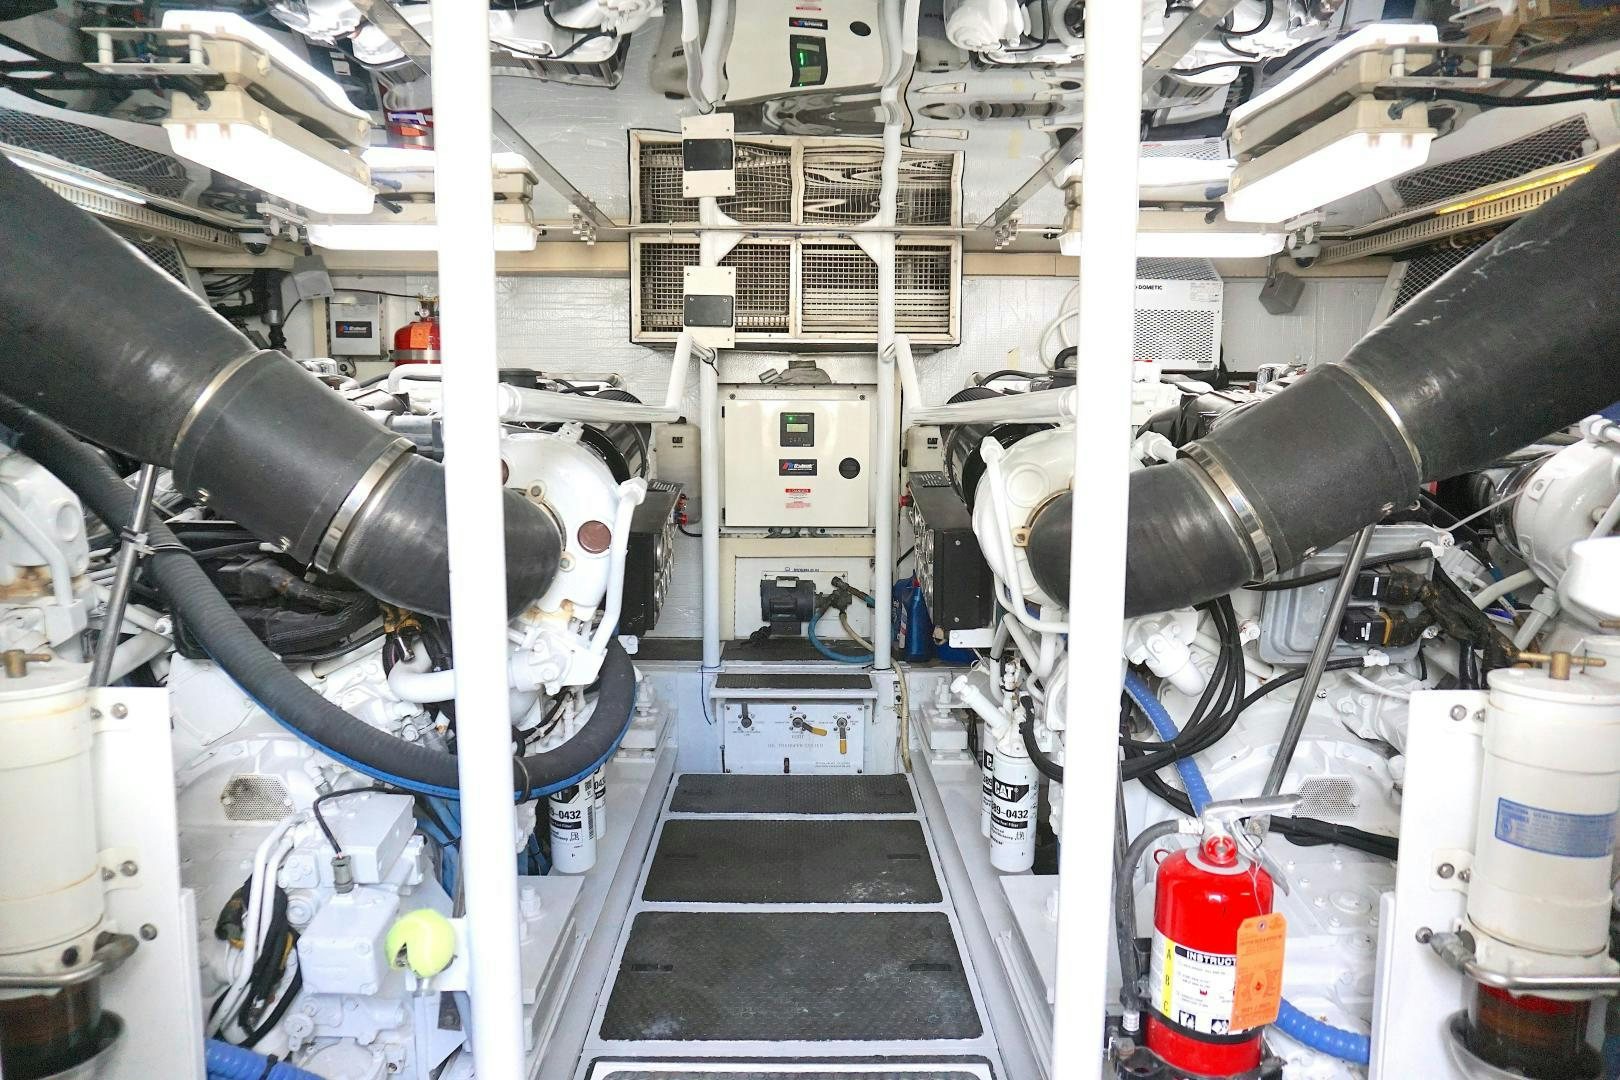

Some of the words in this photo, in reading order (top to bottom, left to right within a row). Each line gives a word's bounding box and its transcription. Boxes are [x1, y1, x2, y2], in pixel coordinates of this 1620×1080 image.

[994, 781, 1014, 800] CAT
[1166, 949, 1172, 961] A
[1165, 974, 1170, 986] B
[1163, 1000, 1168, 1012] C
